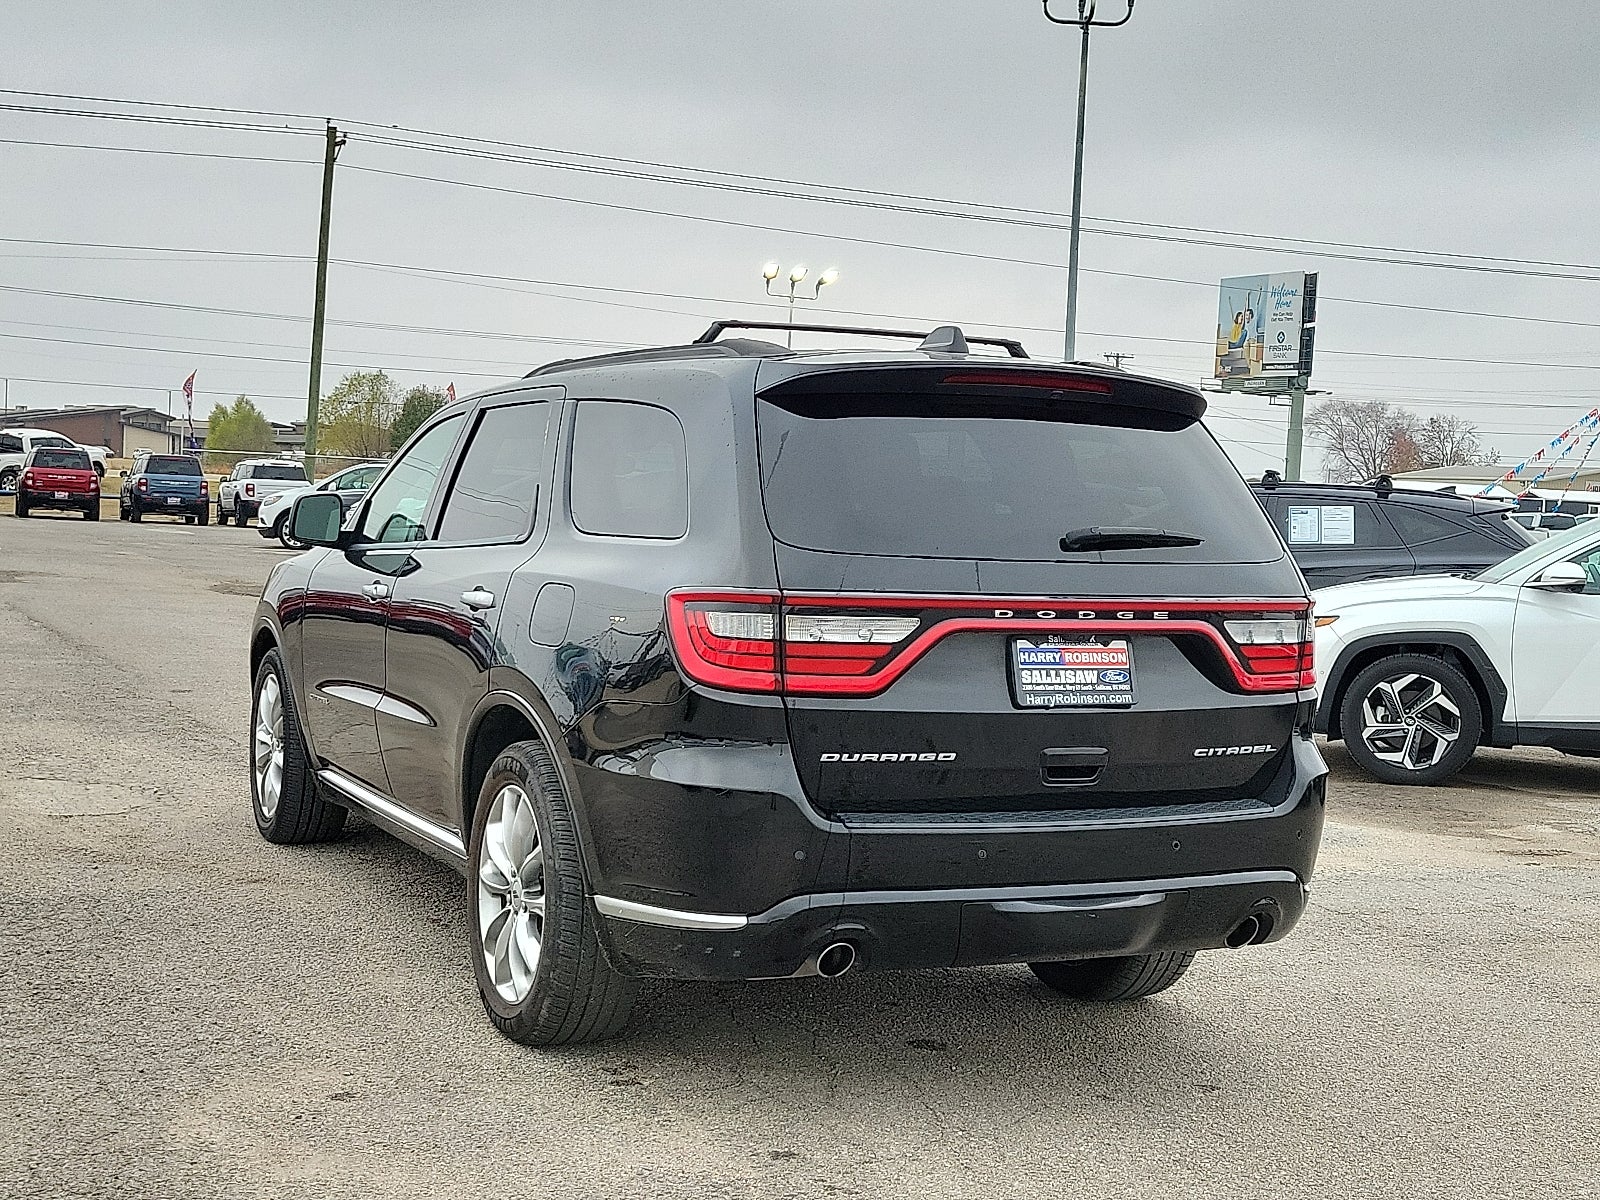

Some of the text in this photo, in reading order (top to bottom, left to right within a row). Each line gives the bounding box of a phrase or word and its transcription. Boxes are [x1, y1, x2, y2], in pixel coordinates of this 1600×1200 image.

[1274, 298, 1292, 310] Home
[1268, 344, 1293, 352] FIRSTAR
[994, 609, 1169, 619] DODGE
[1019, 651, 1127, 663] HARRY ROBINSON
[1021, 669, 1126, 684] SALLISAW Ford
[1026, 693, 1133, 707] HarryRobinson.com
[1193, 744, 1277, 757] CITADEL
[819, 752, 957, 762] DURANGO
